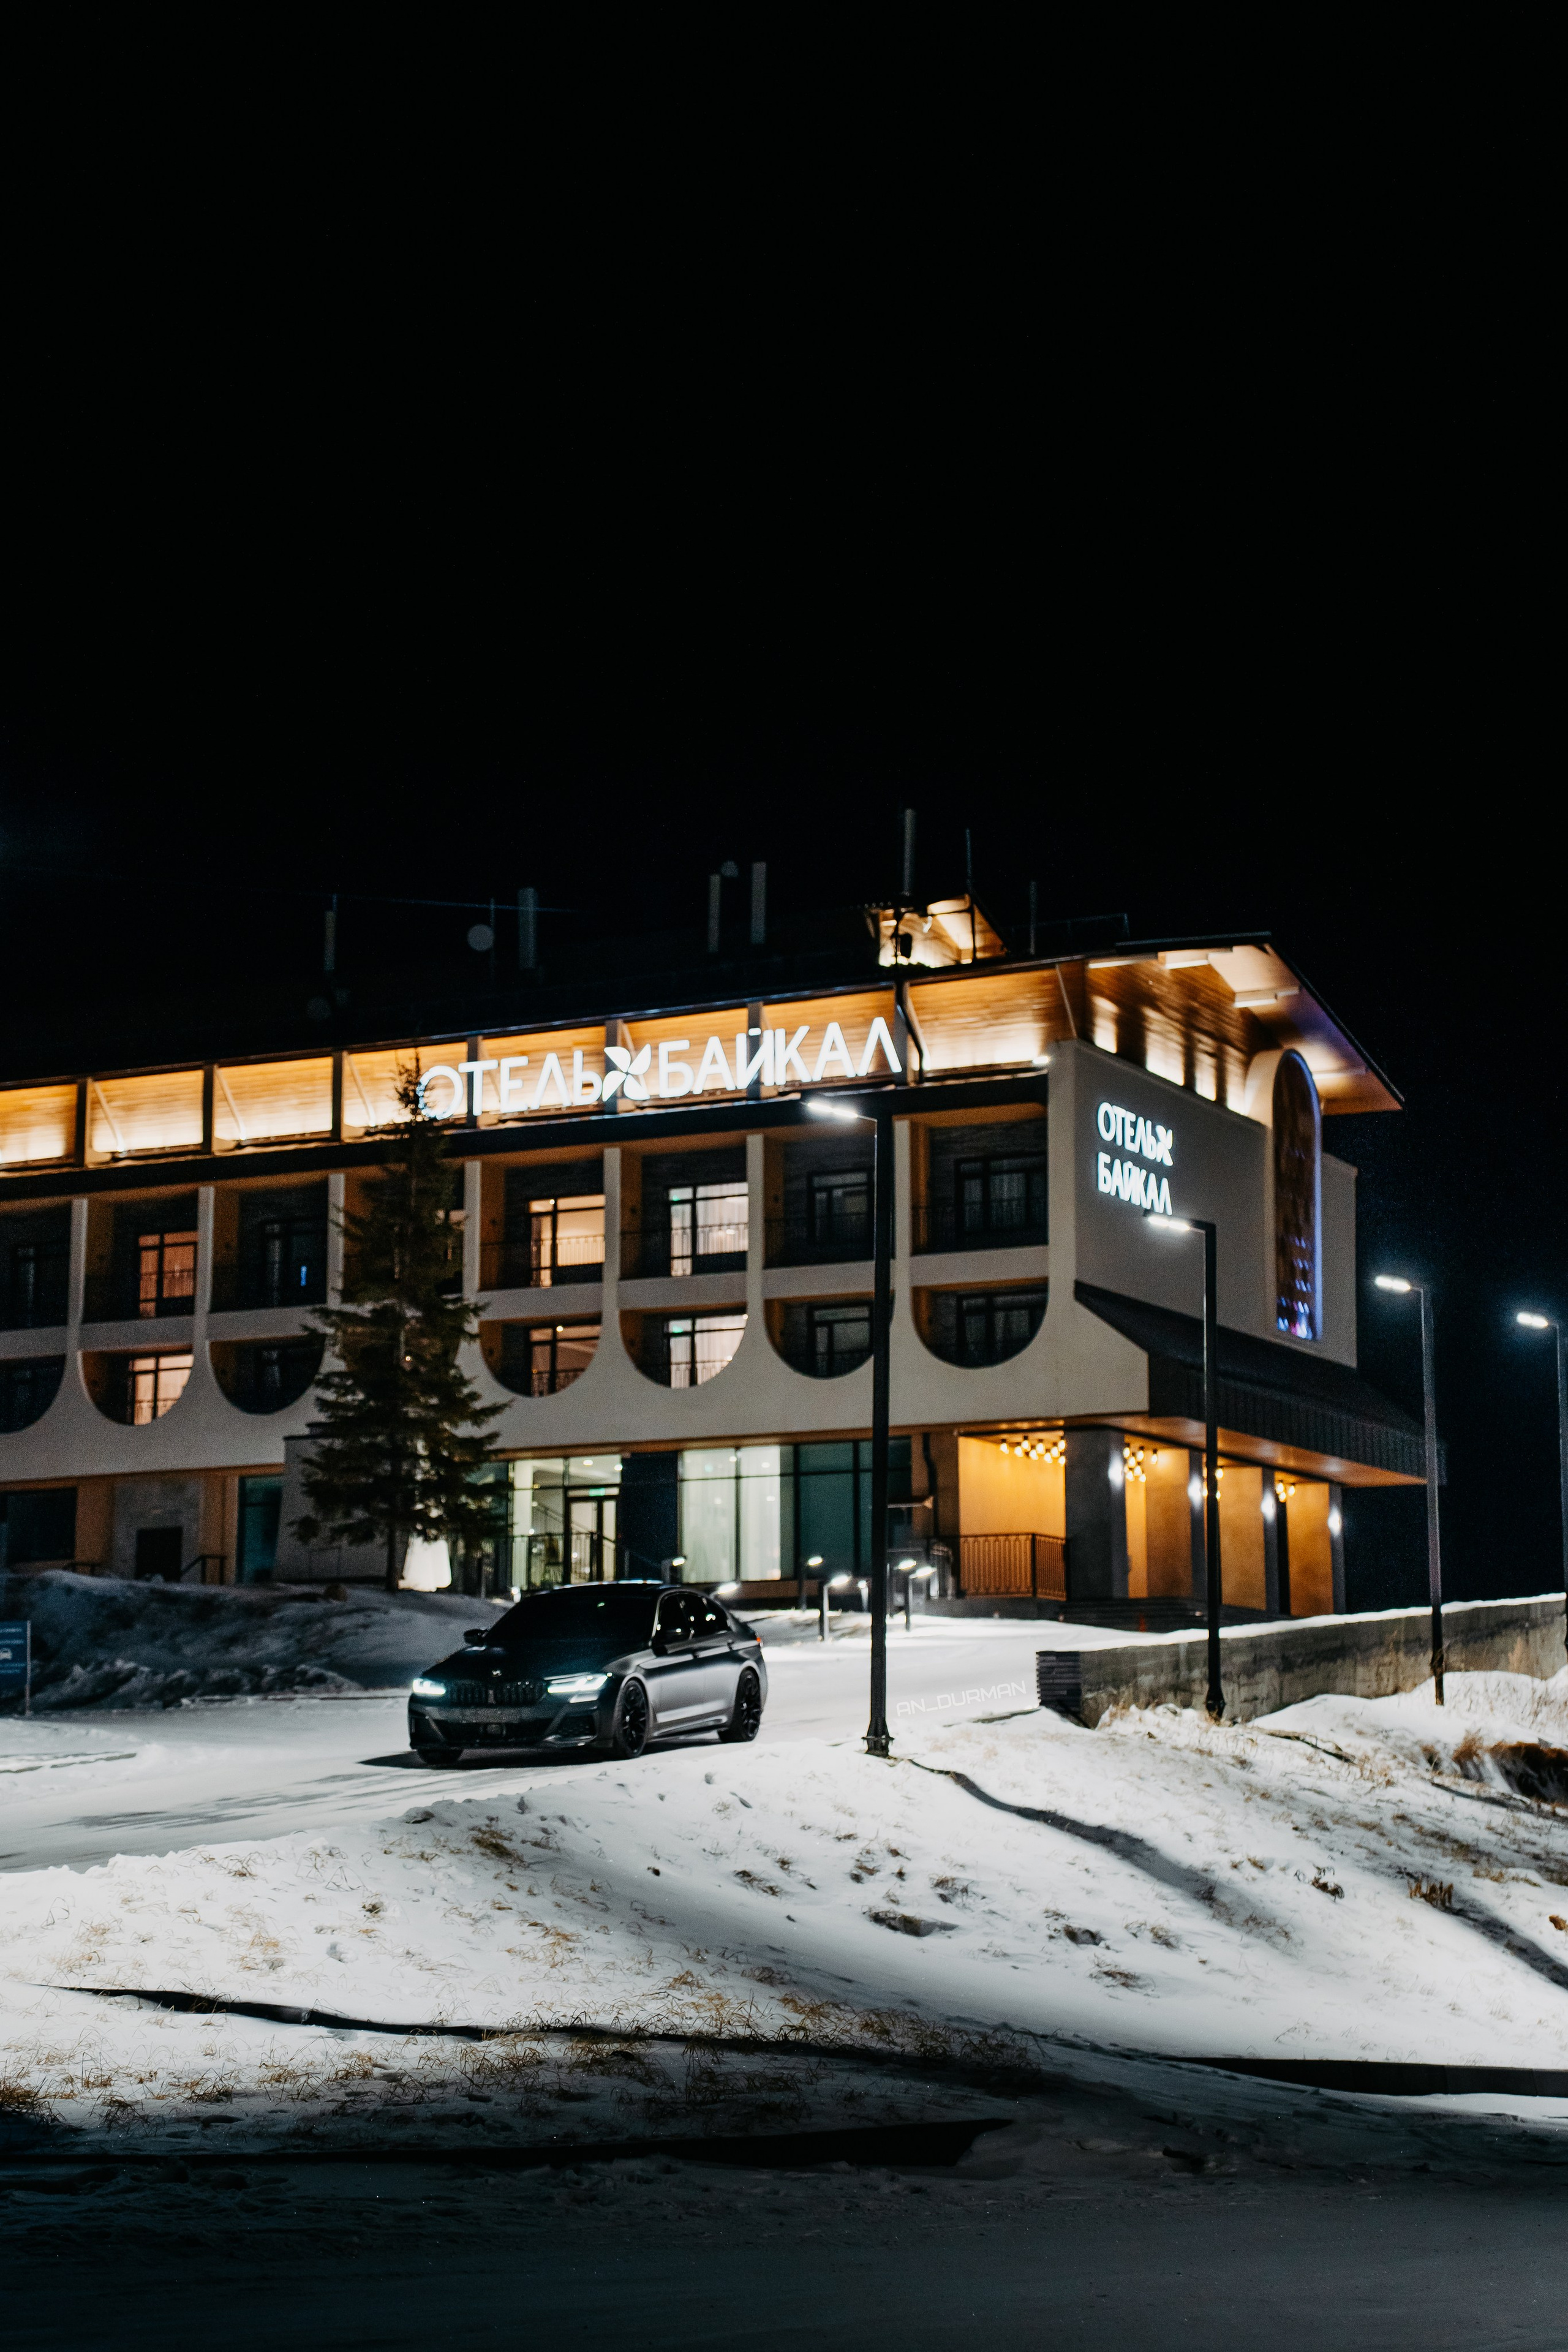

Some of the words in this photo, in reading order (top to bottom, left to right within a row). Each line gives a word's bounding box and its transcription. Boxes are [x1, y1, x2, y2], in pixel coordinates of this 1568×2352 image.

[418, 1050, 603, 1120] ОТЕЛЬ
[658, 1017, 903, 1098] БАЙКАЛ
[1098, 1102, 1157, 1160] ОТЕЛЬ
[1098, 1152, 1173, 1216] БАЙКАЛ
